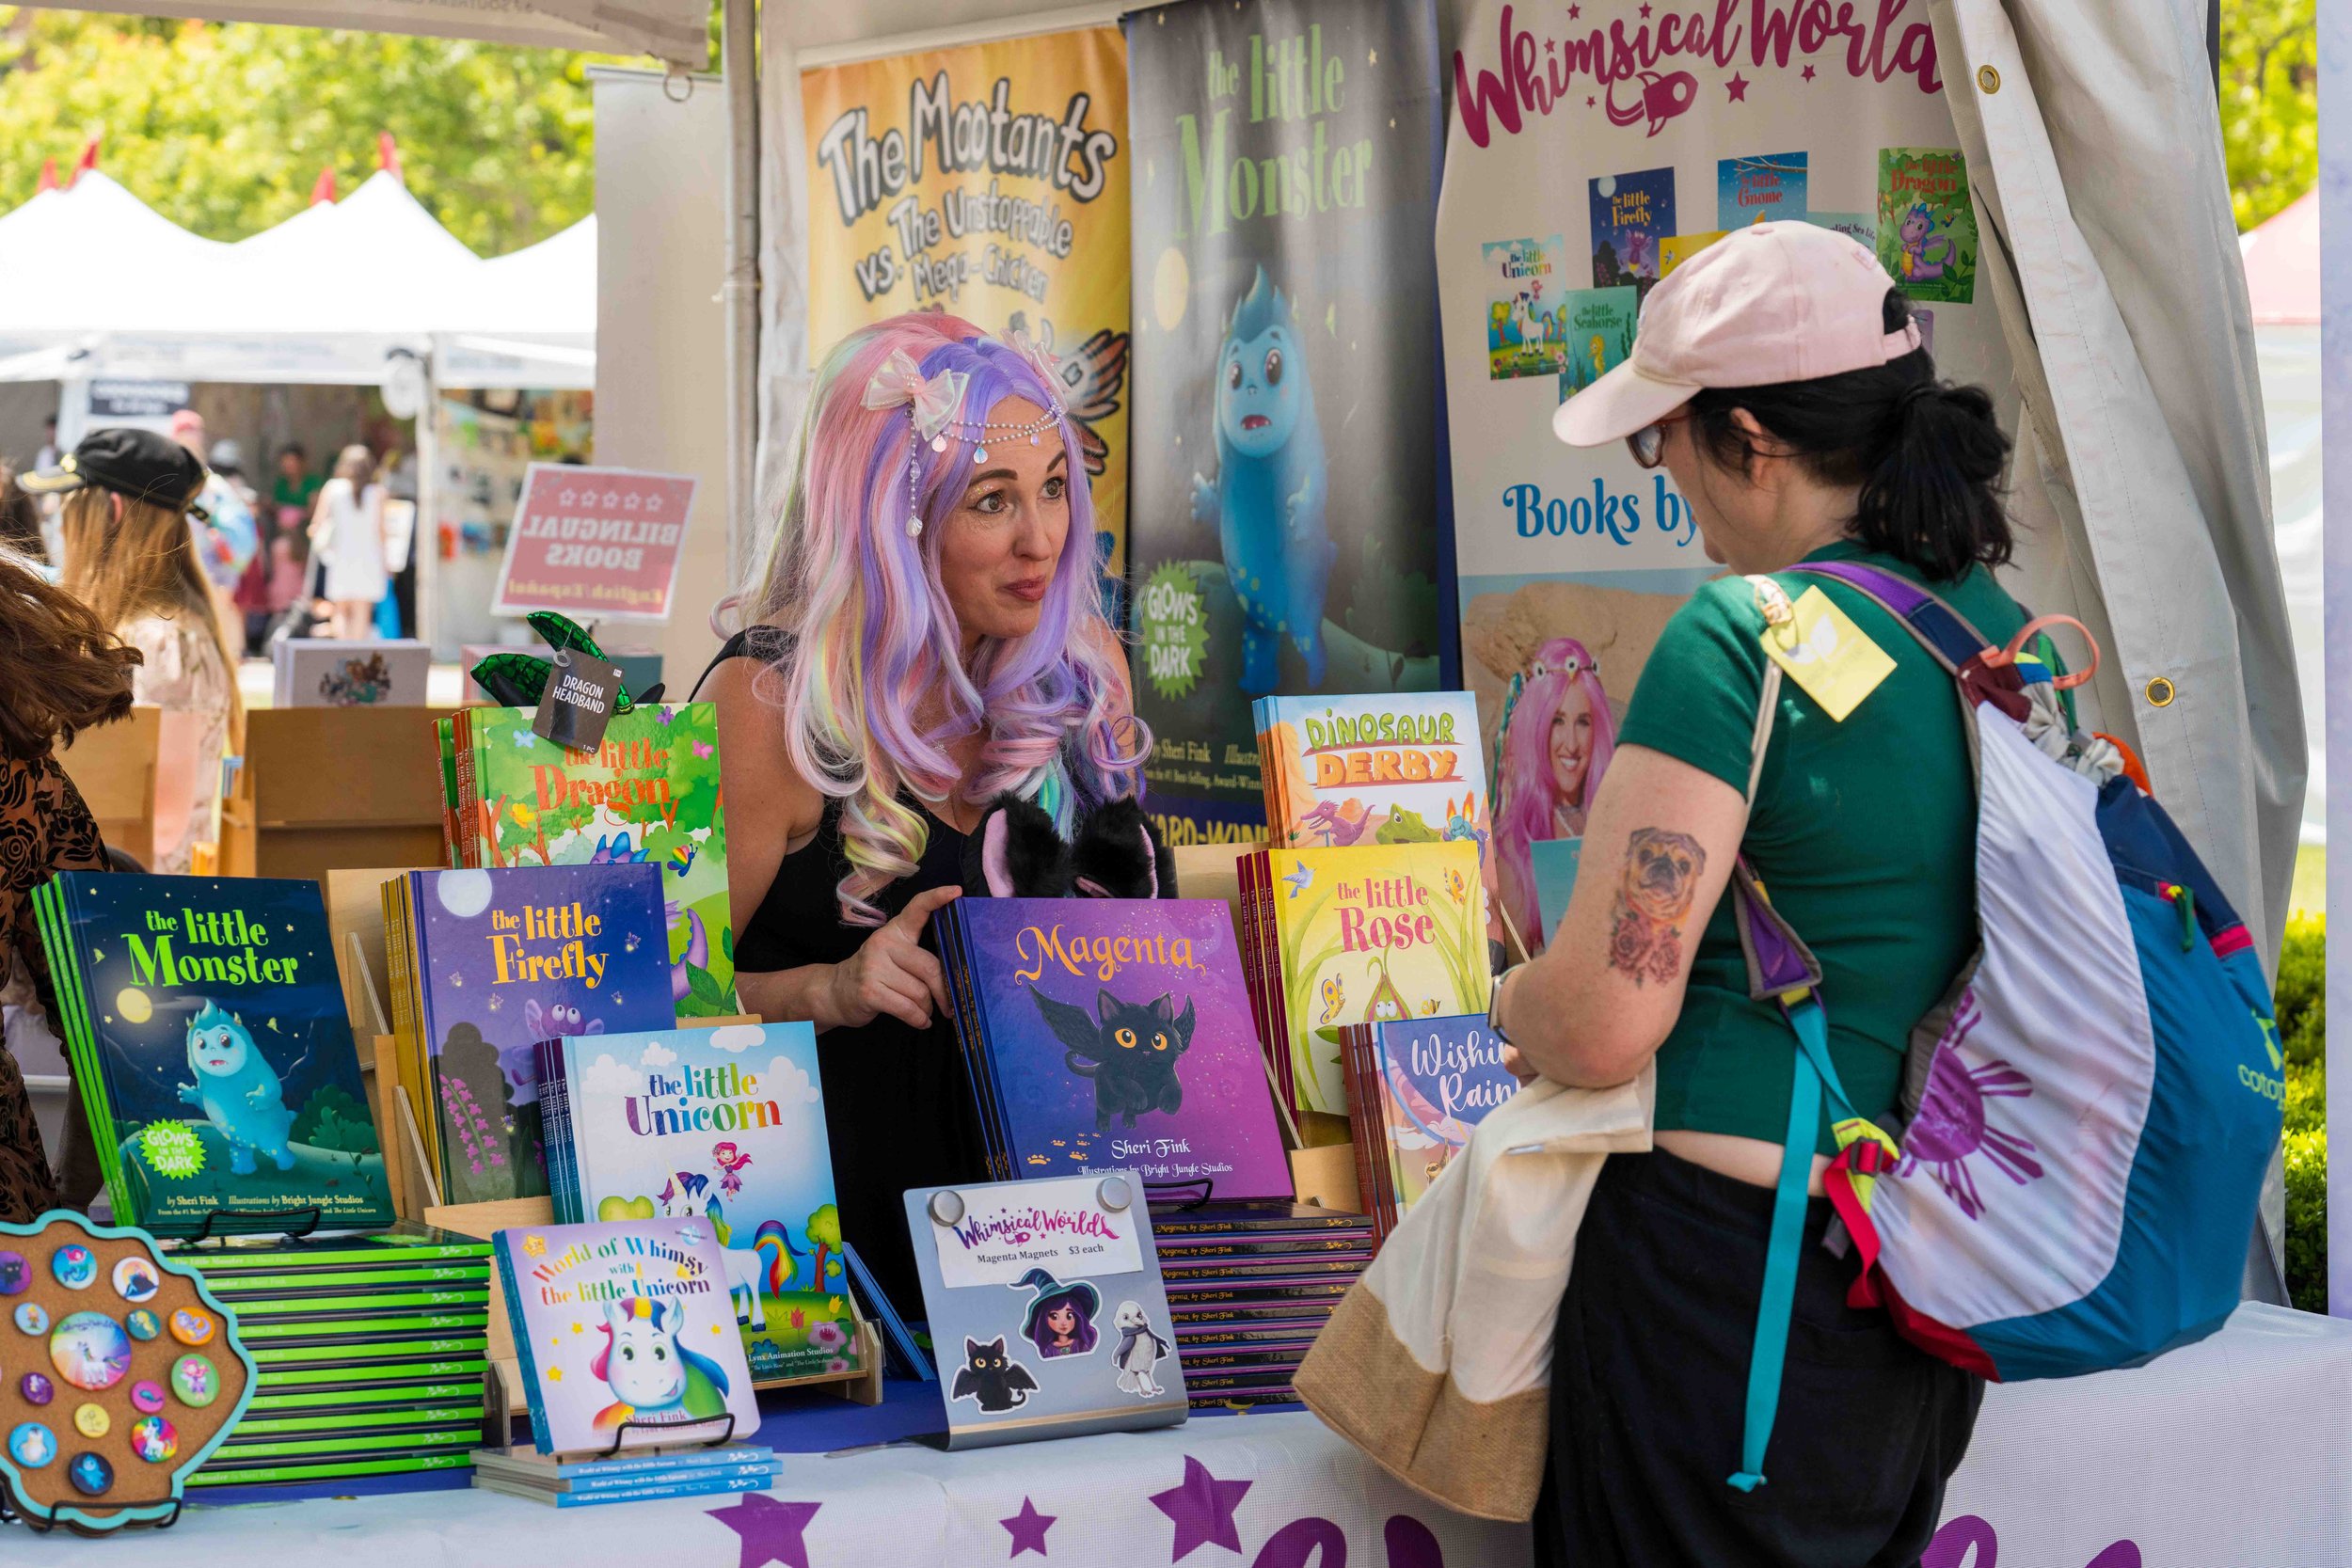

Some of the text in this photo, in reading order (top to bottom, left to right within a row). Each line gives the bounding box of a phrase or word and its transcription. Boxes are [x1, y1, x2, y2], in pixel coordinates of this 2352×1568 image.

[1209, 24, 1346, 123] the little
[1454, 0, 1742, 148] Whimsical
[818, 69, 1118, 227] The Mootants
[1174, 107, 1374, 241] Monster
[1751, 171, 1782, 189] little
[1921, 157, 1959, 176] little
[1890, 170, 1958, 195] Dragon
[1623, 190, 1651, 209] little
[1738, 188, 1784, 208] Gnome
[888, 197, 942, 261] The
[945, 186, 1074, 260] Unstoppable
[1612, 204, 1652, 228] Firefly
[1509, 247, 1546, 263] the little
[912, 243, 1050, 305] Mega-Chicken
[1502, 261, 1552, 279] Unicorn
[1574, 315, 1623, 331] Seahorse
[1591, 303, 1614, 318] little
[1502, 474, 1696, 549] Books by
[1147, 580, 1199, 626] GLOWS
[1153, 624, 1187, 644] IN THE
[1150, 643, 1193, 681] DARK
[552, 685, 605, 714] HEADBAND
[563, 674, 604, 700] DRAGON
[1305, 707, 1455, 749] DINOSAUR
[586, 745, 596, 753] PC
[599, 737, 672, 770] little
[1160, 737, 1185, 762] Sheri
[1186, 740, 1212, 764] Fink
[1314, 749, 1458, 788] DERBY
[527, 764, 672, 827] Dragon
[1337, 875, 1430, 910] the little
[145, 907, 270, 947] the little
[490, 901, 603, 941] the little
[1334, 907, 1437, 956] Rose
[119, 929, 299, 989] Monster
[485, 931, 611, 990] Firefly
[1013, 924, 1208, 987] Magenta
[648, 1062, 759, 1101] the little
[1438, 1072, 1522, 1119] Rain
[624, 1095, 784, 1138] Unicorn
[146, 1128, 195, 1148] GLOWS
[1111, 1138, 1192, 1160] Sheri Fink
[155, 1155, 196, 1171] DARK
[158, 1147, 187, 1157] IN THE
[1140, 1164, 1169, 1179] Bright
[1171, 1163, 1200, 1178] Jungle
[1200, 1162, 1233, 1176] Studios
[167, 1195, 364, 1207] by Sheri Fink Illustrations by Bright Jungle Studios
[952, 1210, 1042, 1251] Whimsical
[1199, 1223, 1216, 1232] Sheri
[1216, 1223, 1232, 1231] Fink
[531, 1235, 708, 1286] World of Whimsy
[977, 1243, 1104, 1265] Magenta Magnets $3 each
[1200, 1246, 1217, 1256] Sheri
[1217, 1245, 1233, 1254] Fink
[609, 1262, 635, 1275] with
[1201, 1268, 1218, 1277] Sheri
[1218, 1268, 1235, 1276] Fink
[541, 1277, 712, 1307] the little Unicorn
[1167, 1293, 1189, 1303] agenta,
[1200, 1291, 1218, 1300] Sheri
[1218, 1291, 1234, 1299] Fink
[748, 1353, 767, 1364] Lynx
[767, 1350, 806, 1361] Animation
[806, 1346, 834, 1356] Studios
[626, 1409, 687, 1425] Sheri Fink
